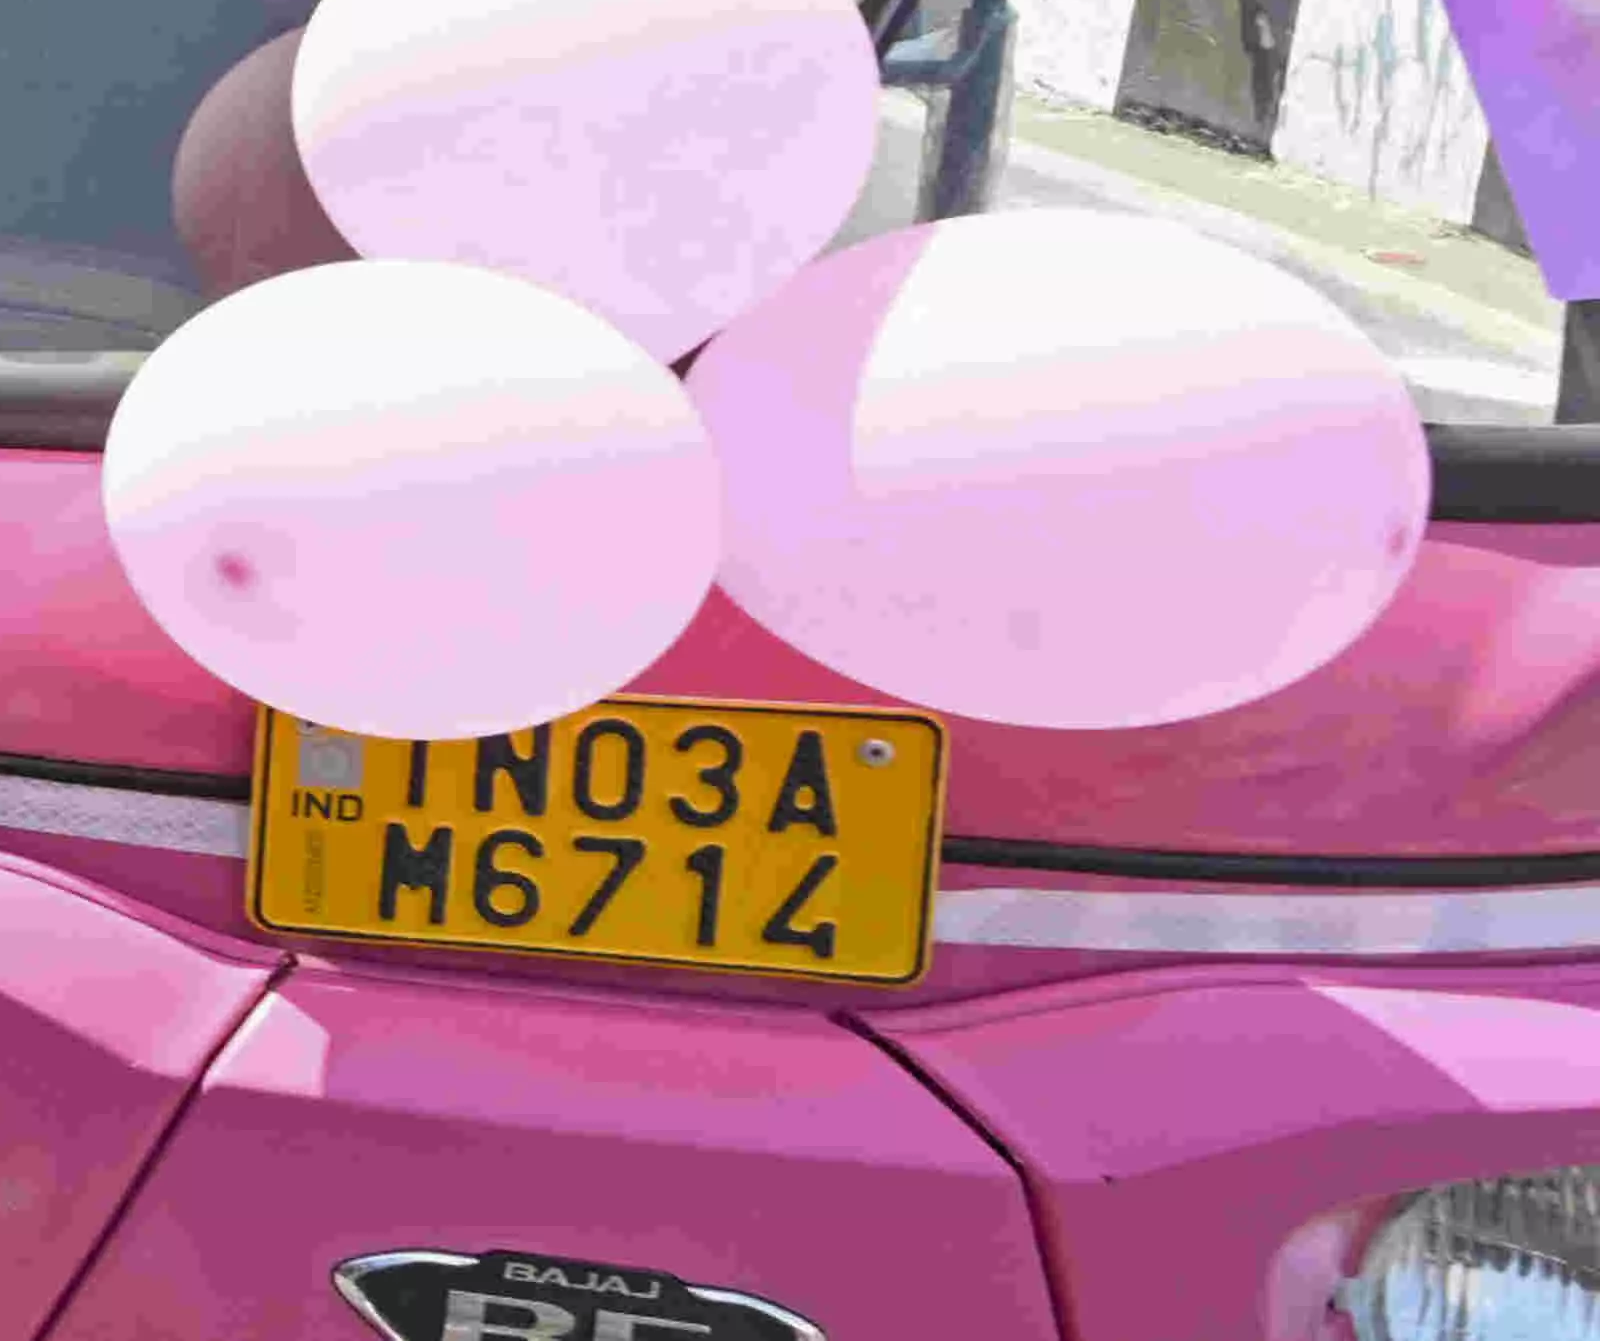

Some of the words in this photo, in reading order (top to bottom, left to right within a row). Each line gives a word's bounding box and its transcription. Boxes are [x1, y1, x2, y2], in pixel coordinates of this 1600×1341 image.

[291, 789, 364, 823] IND
[378, 821, 838, 959] M6714
[503, 1261, 661, 1299] BAJAJ
